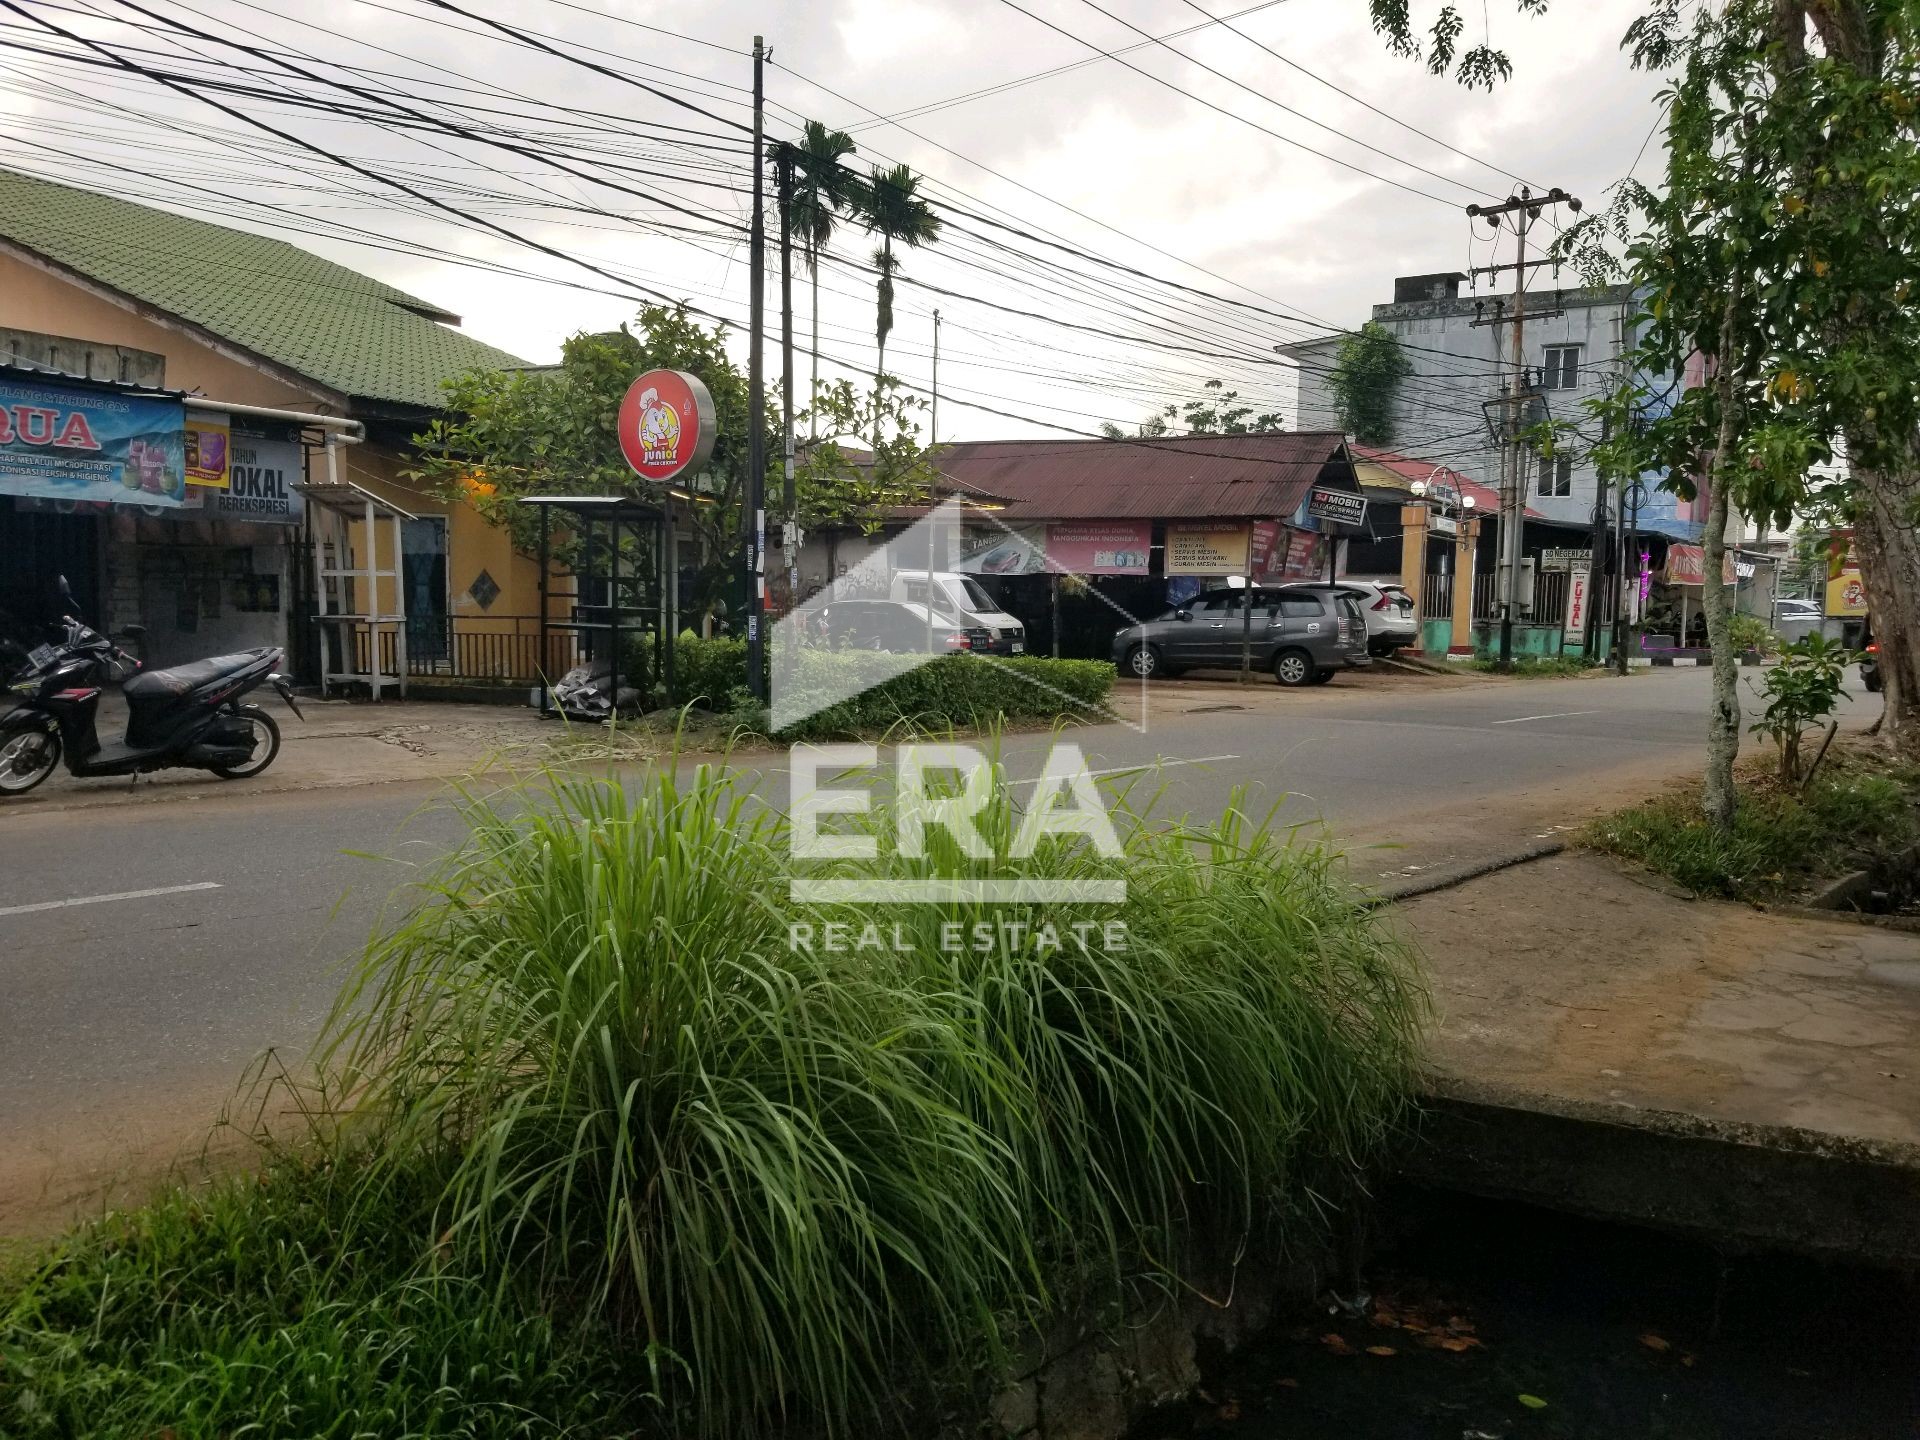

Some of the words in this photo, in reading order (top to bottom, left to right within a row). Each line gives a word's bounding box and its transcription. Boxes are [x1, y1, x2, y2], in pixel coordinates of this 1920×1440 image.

[54, 393, 105, 409] TABUNG
[105, 400, 129, 413] GAS
[17, 456, 53, 467] MELALUI
[231, 448, 257, 465] TAHUN
[643, 447, 677, 464] junior
[40, 469, 68, 478] BERSIH
[77, 473, 110, 481] HIGIENIS
[221, 465, 289, 499] OKAL
[1328, 496, 1361, 508] MOBIL
[1554, 550, 1578, 558] NEGERI
[1579, 550, 1589, 558] 24
[1571, 581, 1583, 627] FUTSAL
